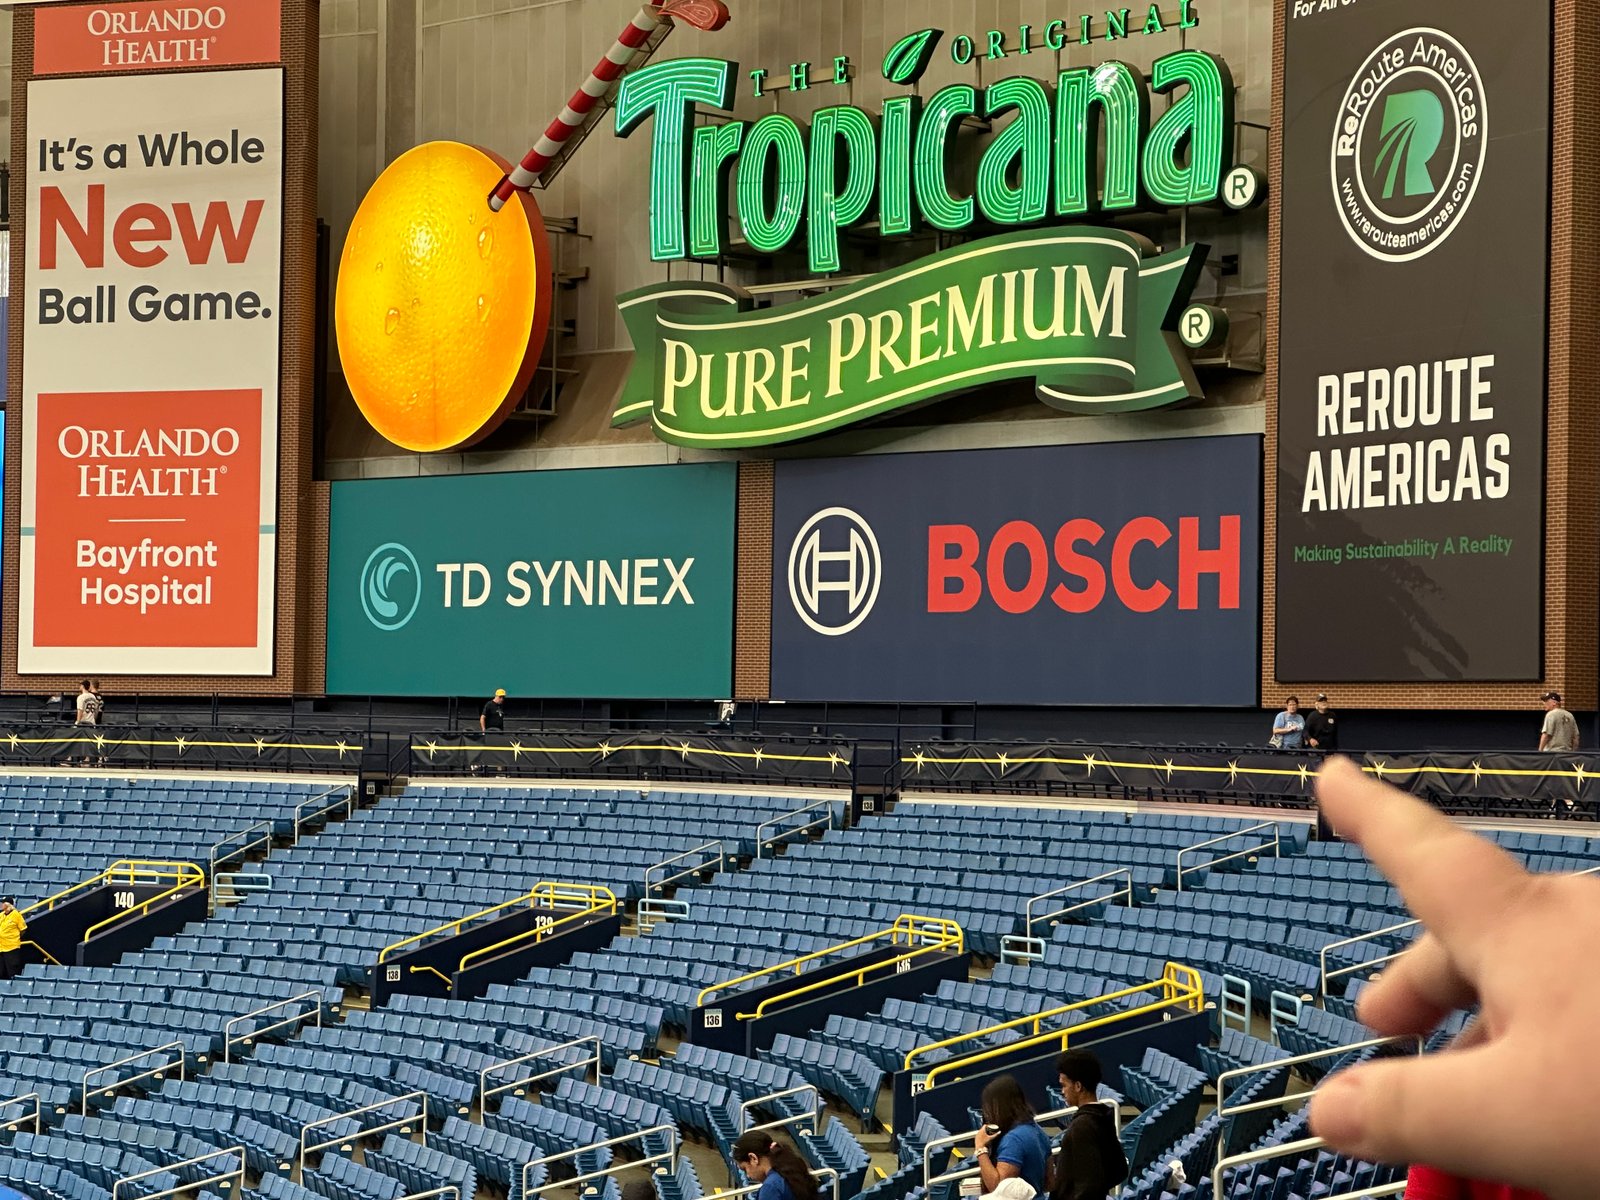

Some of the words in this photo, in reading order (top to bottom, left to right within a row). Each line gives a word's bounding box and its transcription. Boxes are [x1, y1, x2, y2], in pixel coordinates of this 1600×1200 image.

[87, 6, 226, 35] ORLANDO
[1293, 0, 1316, 18] For
[750, 55, 850, 97] THE
[951, 0, 1199, 64] ORIGINAL
[1337, 47, 1405, 156] ReRoute
[1410, 36, 1478, 138] Americas
[39, 138, 94, 171] It's
[103, 143, 127, 169] a
[138, 129, 264, 167] Whole
[615, 49, 1232, 272] Tropicana
[1341, 162, 1474, 248] www.rerouteamericas.com
[39, 184, 265, 270] New
[39, 285, 116, 324] Ball
[128, 285, 272, 322] Game.
[660, 337, 811, 419] PURE
[824, 265, 1129, 398] PREMIUM
[1317, 354, 1495, 437] REROUTE
[58, 426, 239, 458] ORLANDO
[1301, 433, 1510, 512] AMERICAS
[76, 538, 217, 575] Bayfront
[927, 514, 1241, 614] BOSCH
[1294, 545, 1342, 565] Making
[1345, 538, 1439, 560] Sustainability
[1443, 537, 1456, 554] A
[1459, 534, 1513, 556] Reality
[80, 575, 211, 614] Hospital
[436, 562, 491, 607] TD
[506, 557, 695, 607] SYNNEX
[114, 892, 135, 908] 140
[387, 970, 399, 980] 138
[706, 1015, 720, 1026] 136
